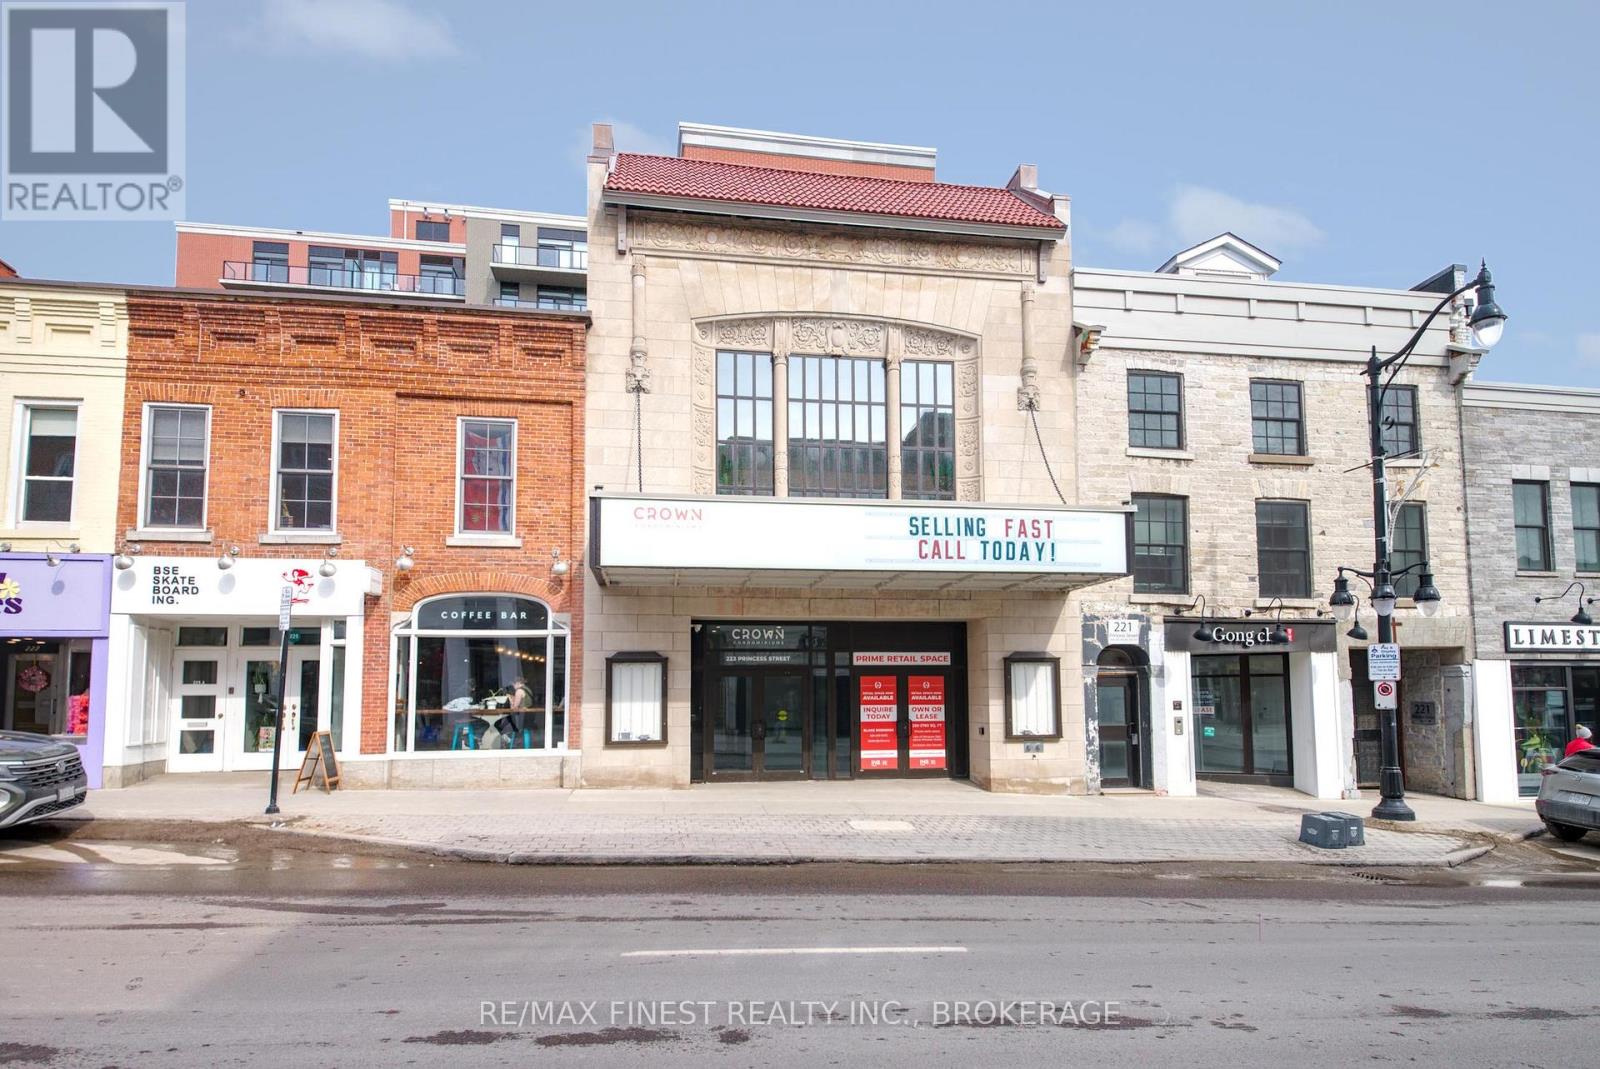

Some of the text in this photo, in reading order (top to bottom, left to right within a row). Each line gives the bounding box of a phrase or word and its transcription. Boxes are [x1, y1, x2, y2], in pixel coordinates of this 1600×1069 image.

[633, 506, 702, 521] CROWN
[909, 516, 1053, 539] SELLING FAST
[918, 539, 1056, 562] CALL TODAY!
[153, 566, 179, 575] BSE
[152, 576, 196, 585] SKATE
[152, 586, 199, 595] BOARD
[151, 595, 179, 605] ING.
[440, 611, 528, 619] COFFEE BAR
[1114, 621, 1132, 632] 221
[731, 628, 785, 640] CROWN
[1212, 626, 1255, 647] Gong
[1513, 628, 1600, 646] LIMEST
[856, 655, 949, 663] PRIME RETAIL SPACE
[1415, 703, 1430, 714] 221
